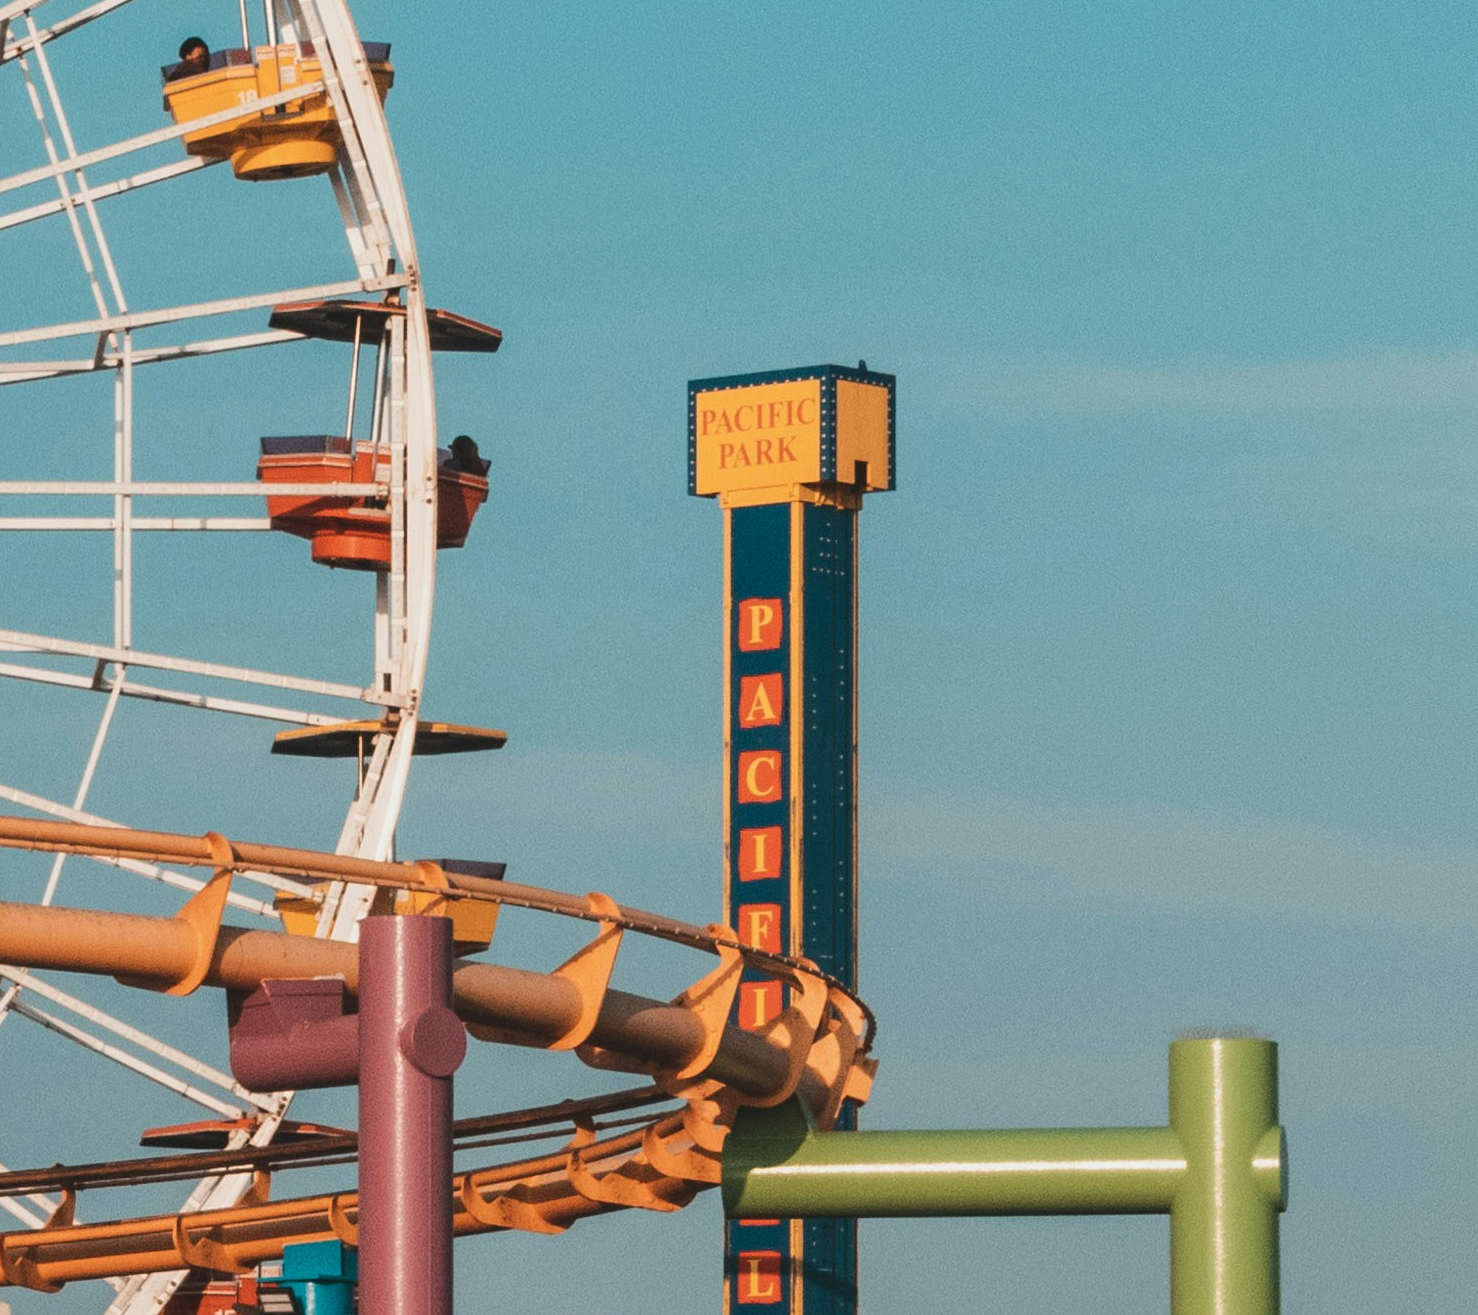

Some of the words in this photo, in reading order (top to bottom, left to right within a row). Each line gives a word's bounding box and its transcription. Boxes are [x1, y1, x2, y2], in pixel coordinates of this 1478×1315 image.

[700, 397, 817, 436] PACIFIC
[718, 435, 797, 470] PARK
[745, 604, 778, 1028] PACIFI
